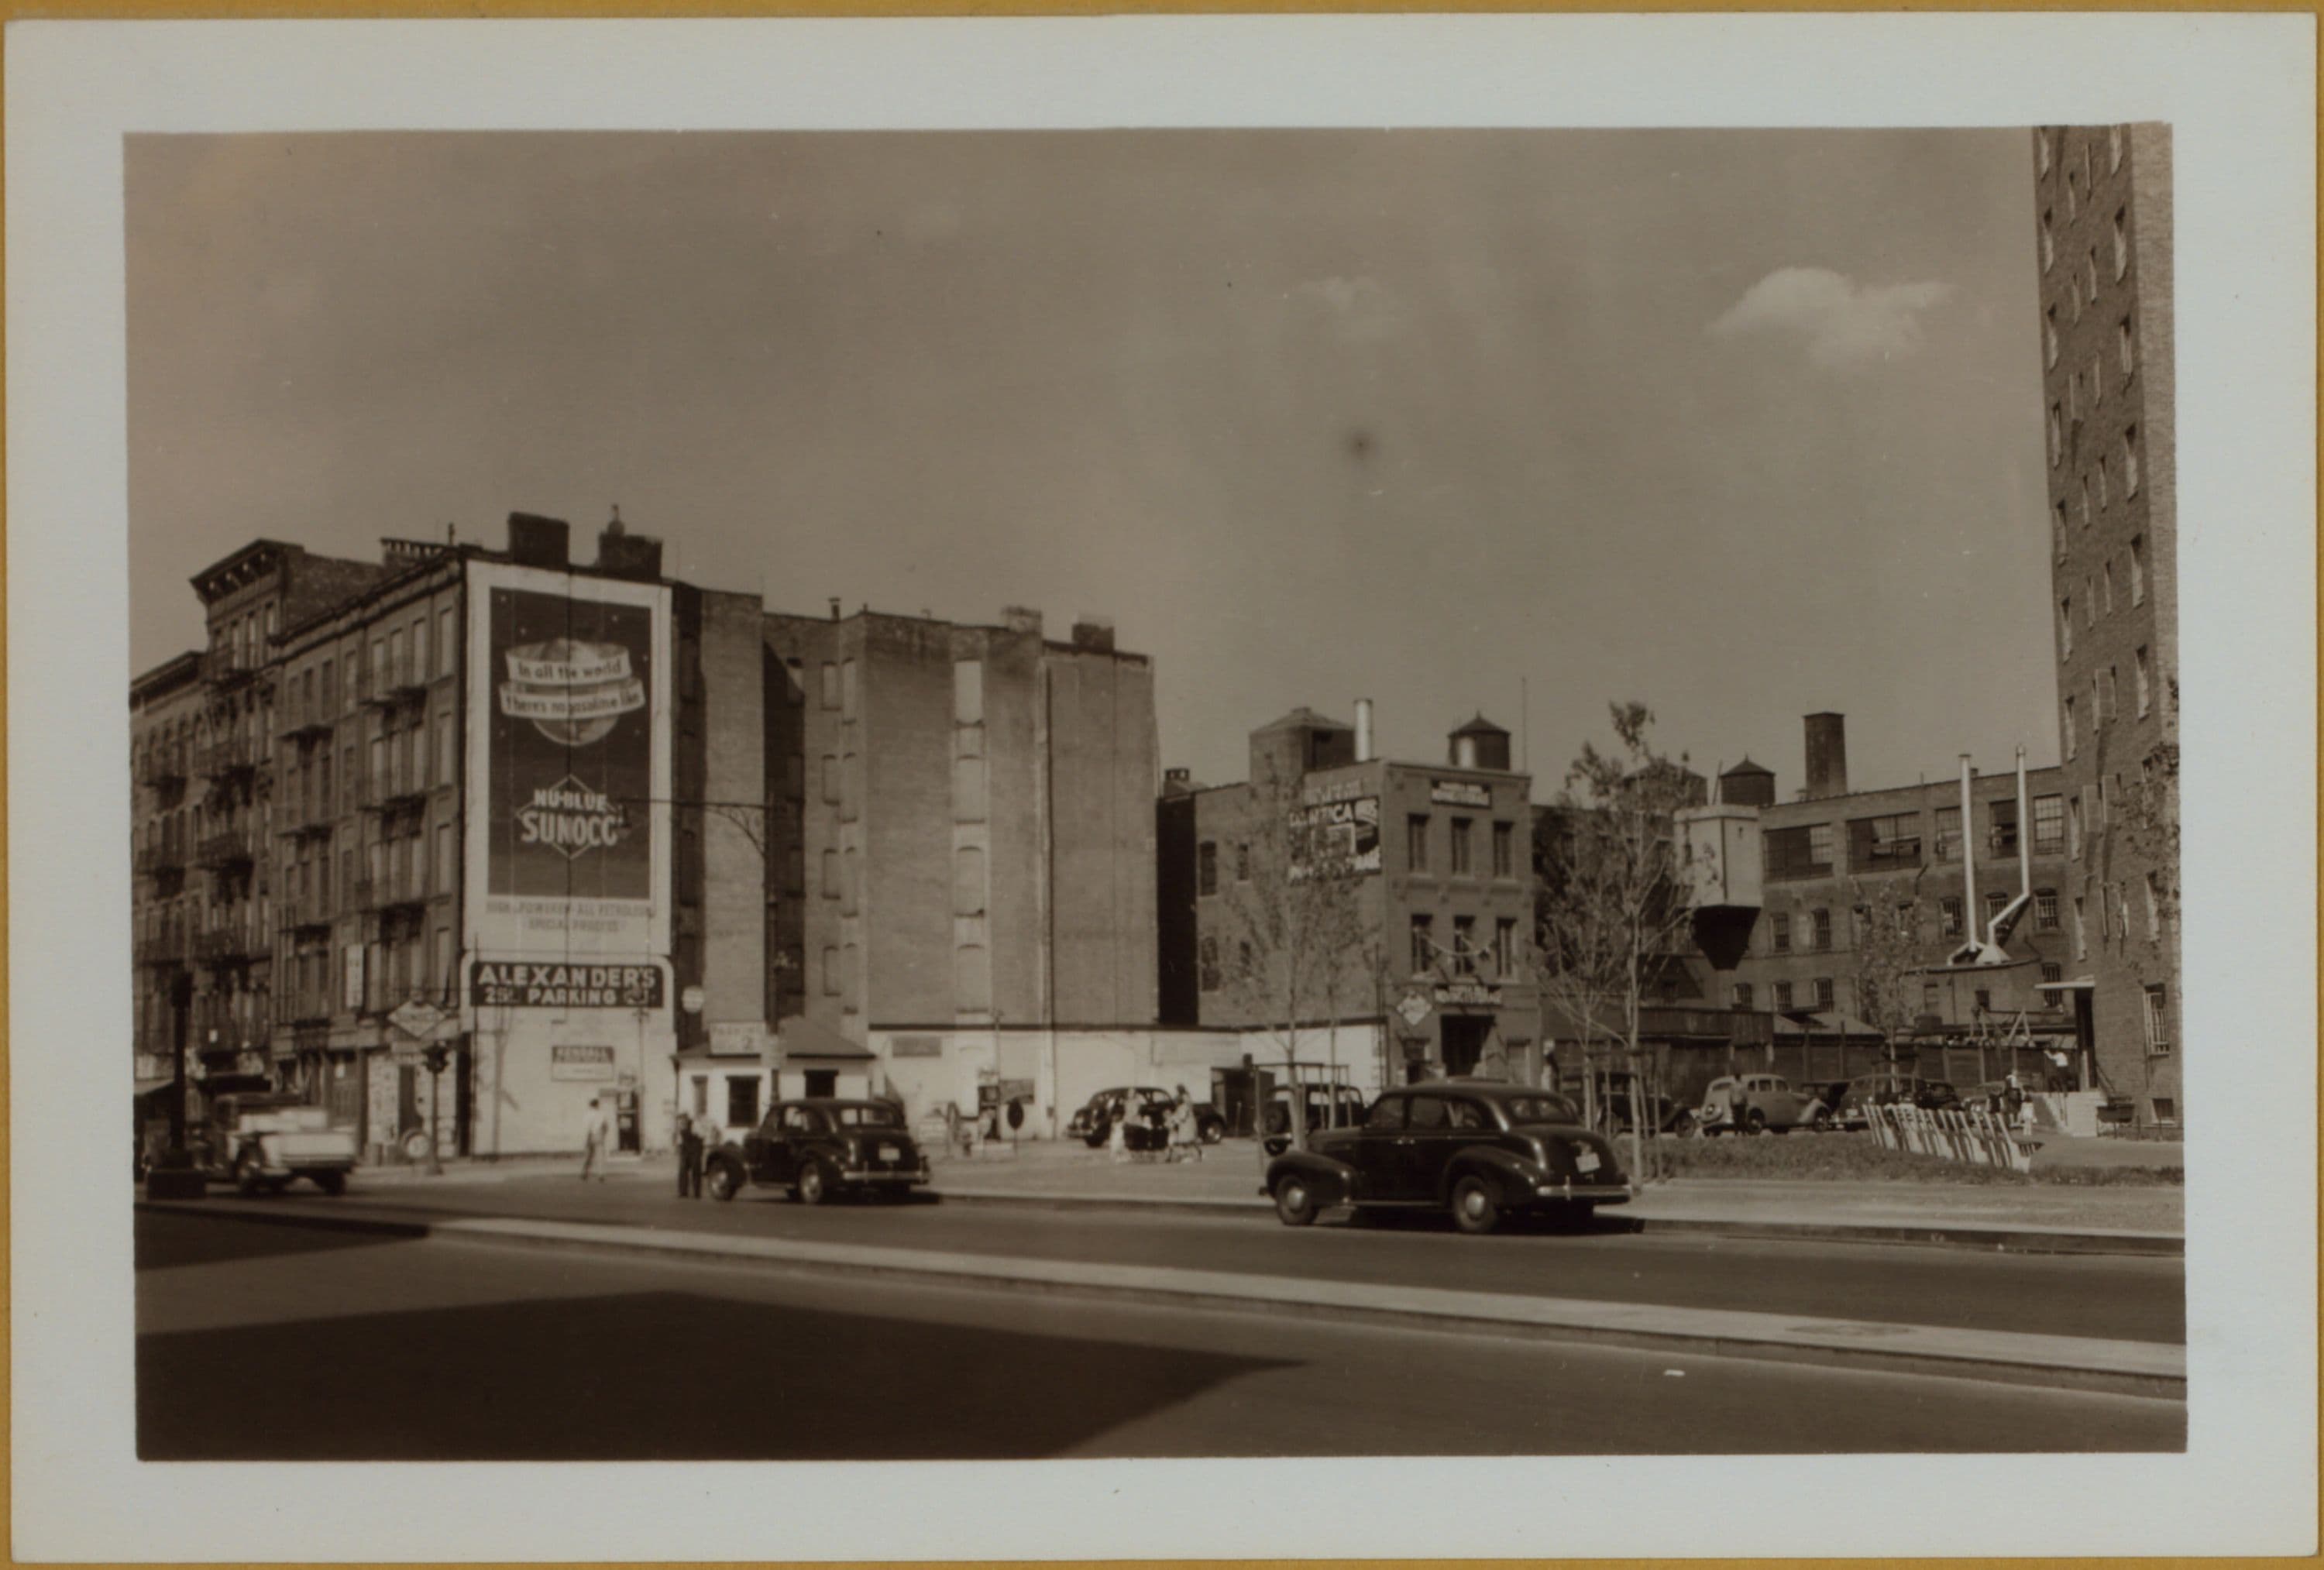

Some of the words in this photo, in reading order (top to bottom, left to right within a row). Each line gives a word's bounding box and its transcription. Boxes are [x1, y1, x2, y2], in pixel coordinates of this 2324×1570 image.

[517, 661, 531, 678] In
[535, 664, 553, 679] all
[557, 665, 578, 679] the
[583, 658, 621, 678] world
[533, 788, 609, 813] NU-BLUE
[478, 964, 656, 989] ALEXANDER'S
[528, 988, 618, 1005] PARKING
